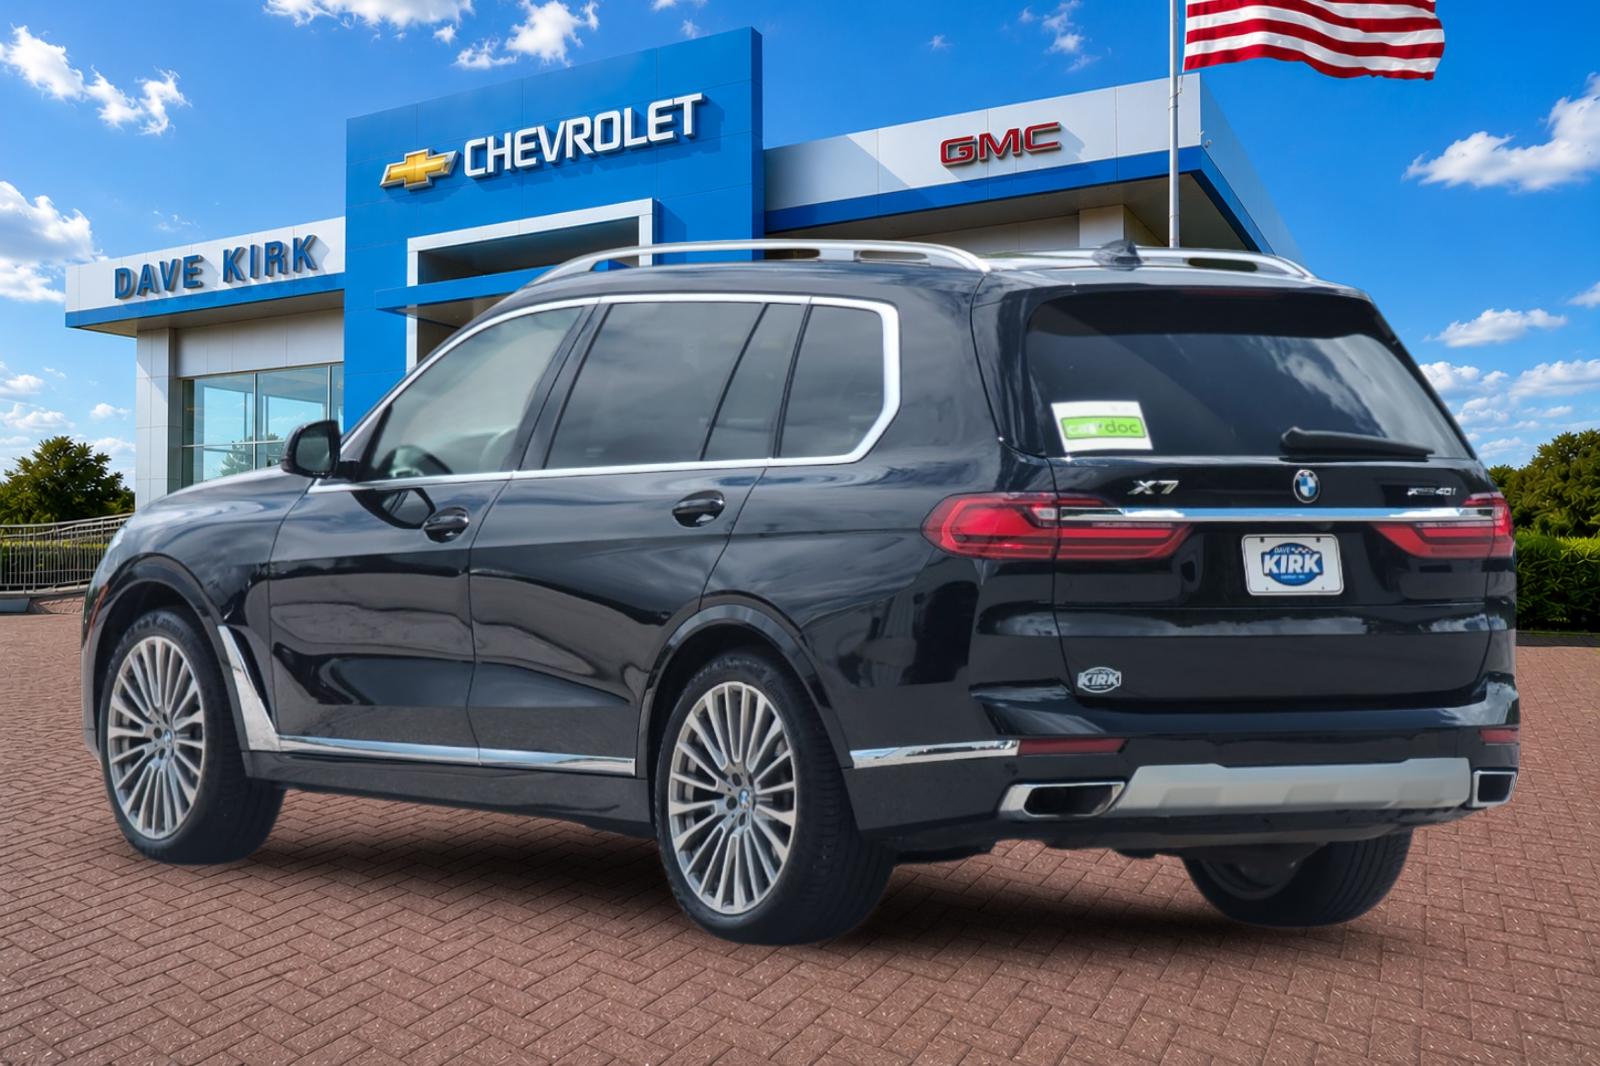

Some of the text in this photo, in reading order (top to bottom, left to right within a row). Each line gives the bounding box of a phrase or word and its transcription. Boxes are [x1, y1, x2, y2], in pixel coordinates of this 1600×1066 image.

[464, 93, 703, 177] CHEVROLET
[940, 121, 1061, 165] GMC
[115, 235, 318, 299] DAVE KIRK
[1128, 480, 1180, 494] X7
[1263, 554, 1321, 574] KIRK
[1078, 673, 1118, 686] KIRK
